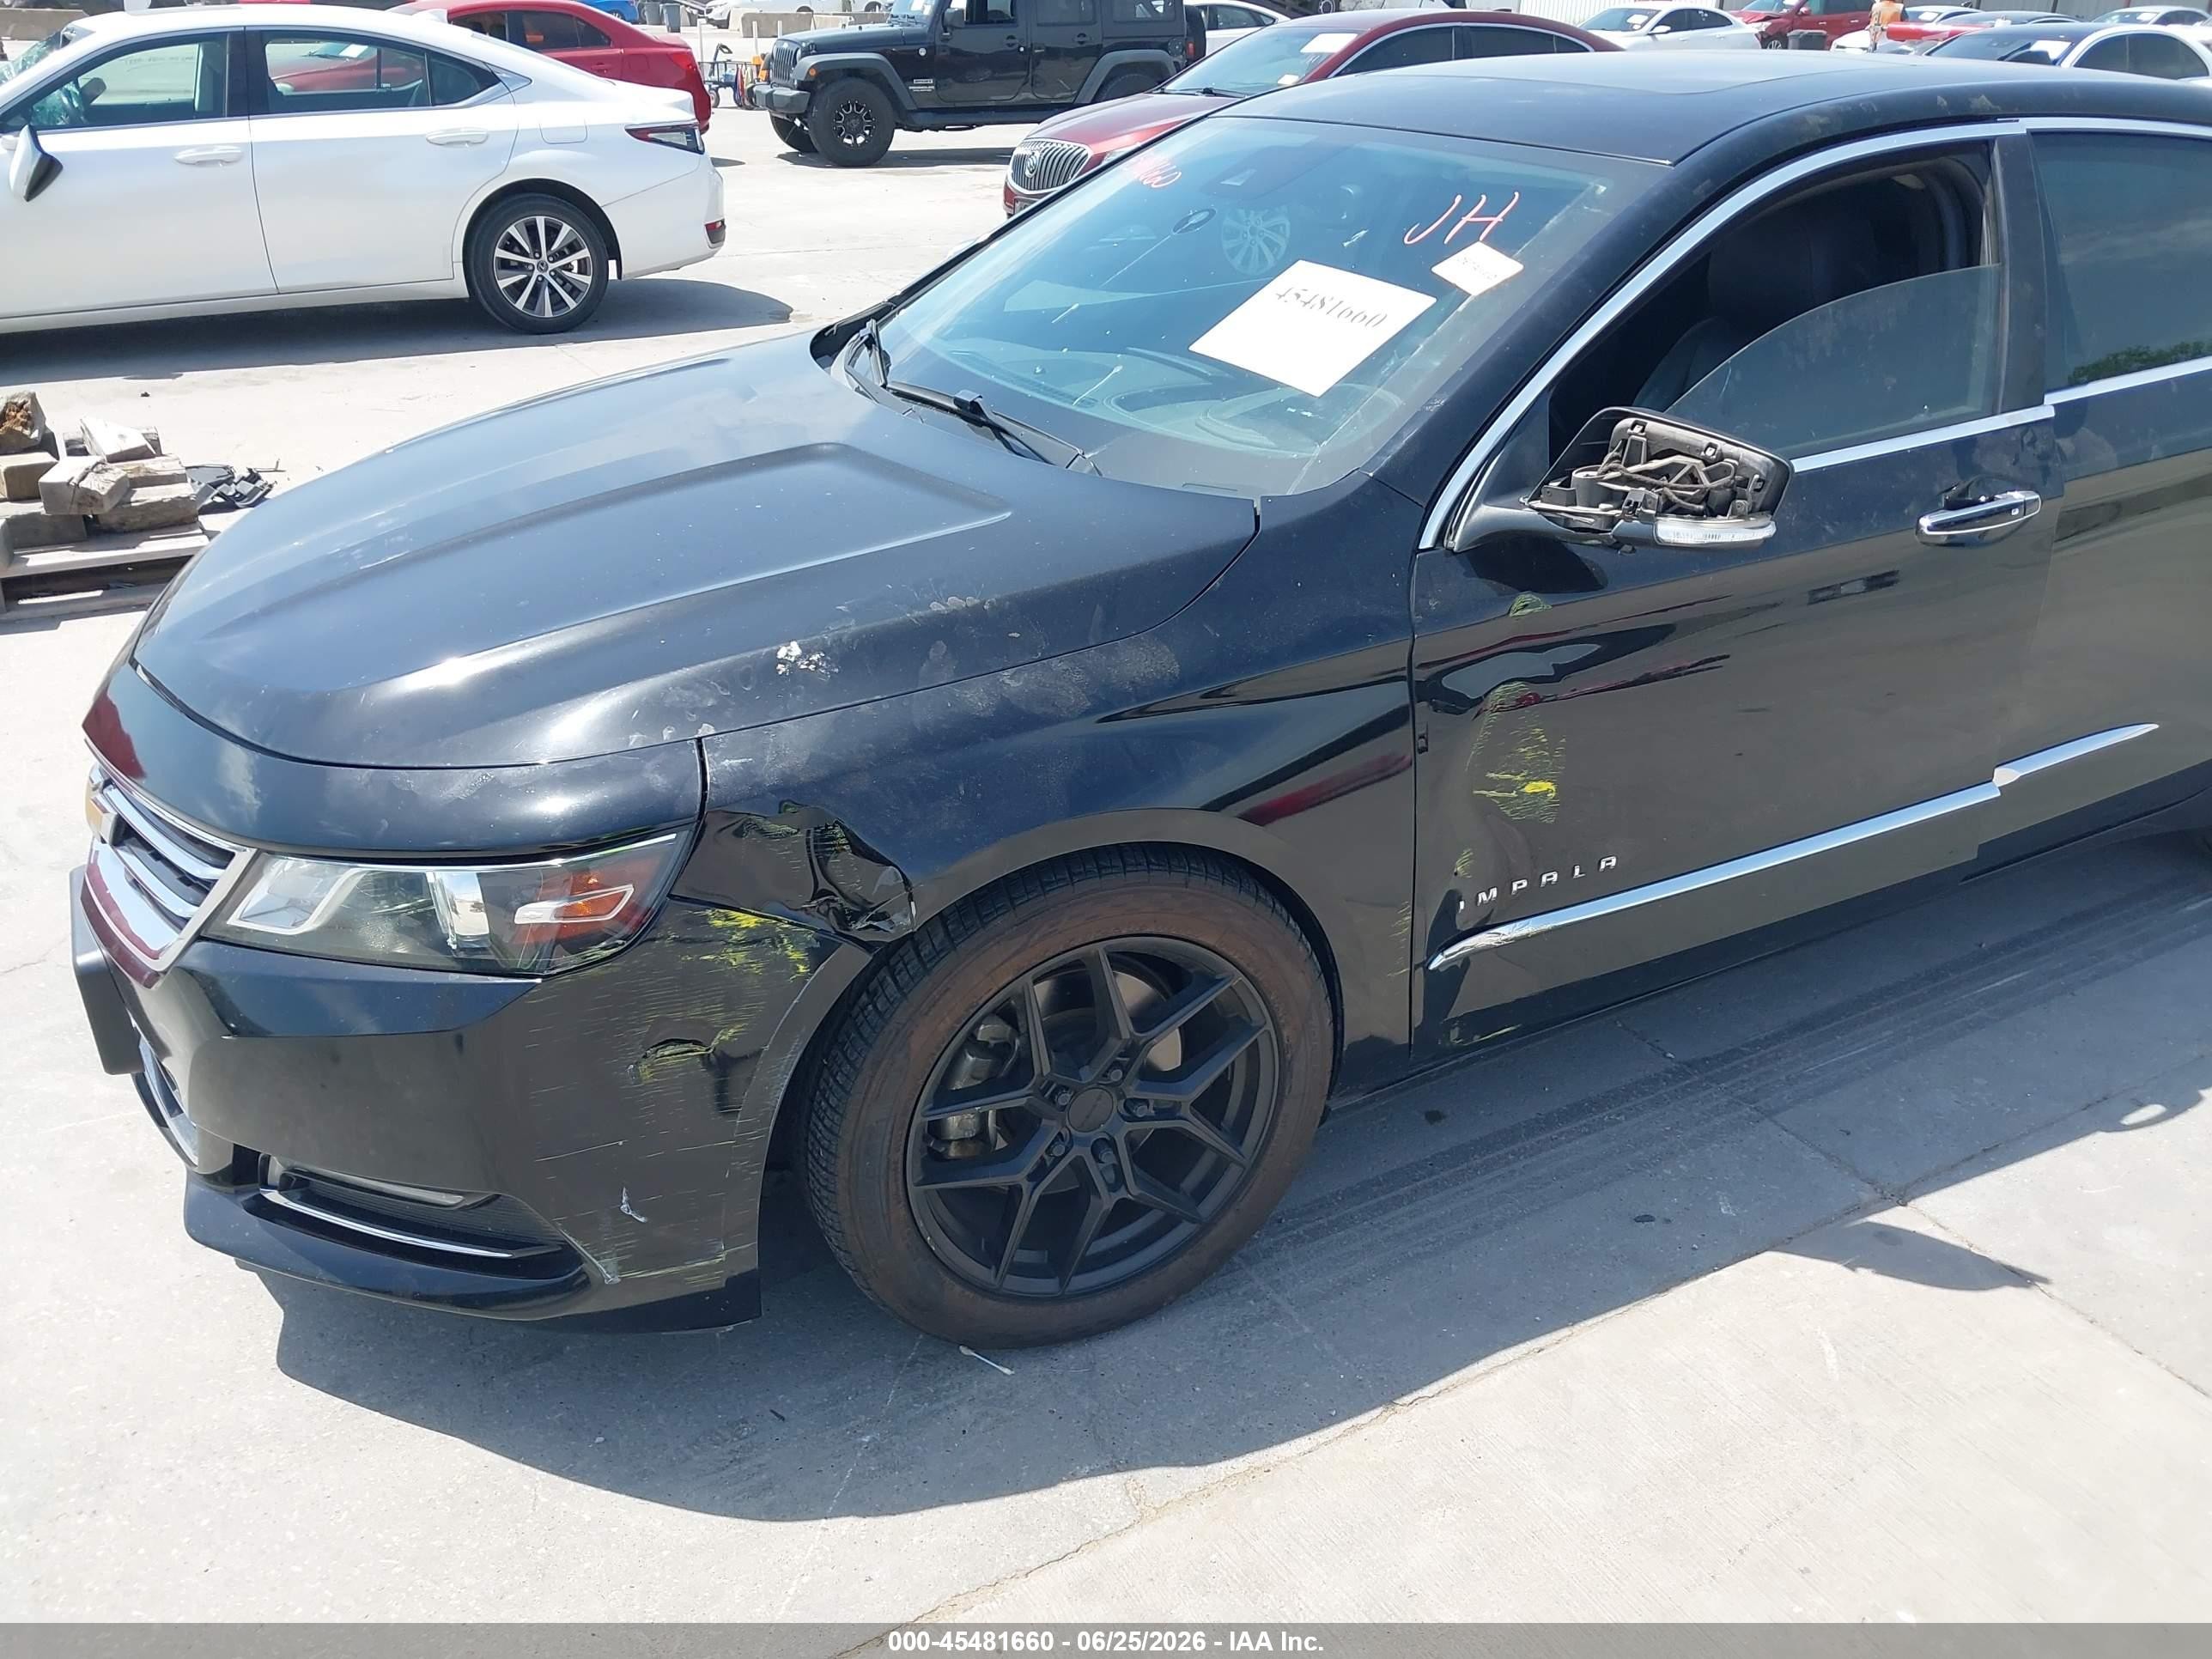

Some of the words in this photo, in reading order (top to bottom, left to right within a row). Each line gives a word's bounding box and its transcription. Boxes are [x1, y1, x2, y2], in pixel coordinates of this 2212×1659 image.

[1404, 191, 1520, 245] JH
[1275, 287, 1388, 328] 45481660
[1458, 854, 1618, 914] IMPALA
